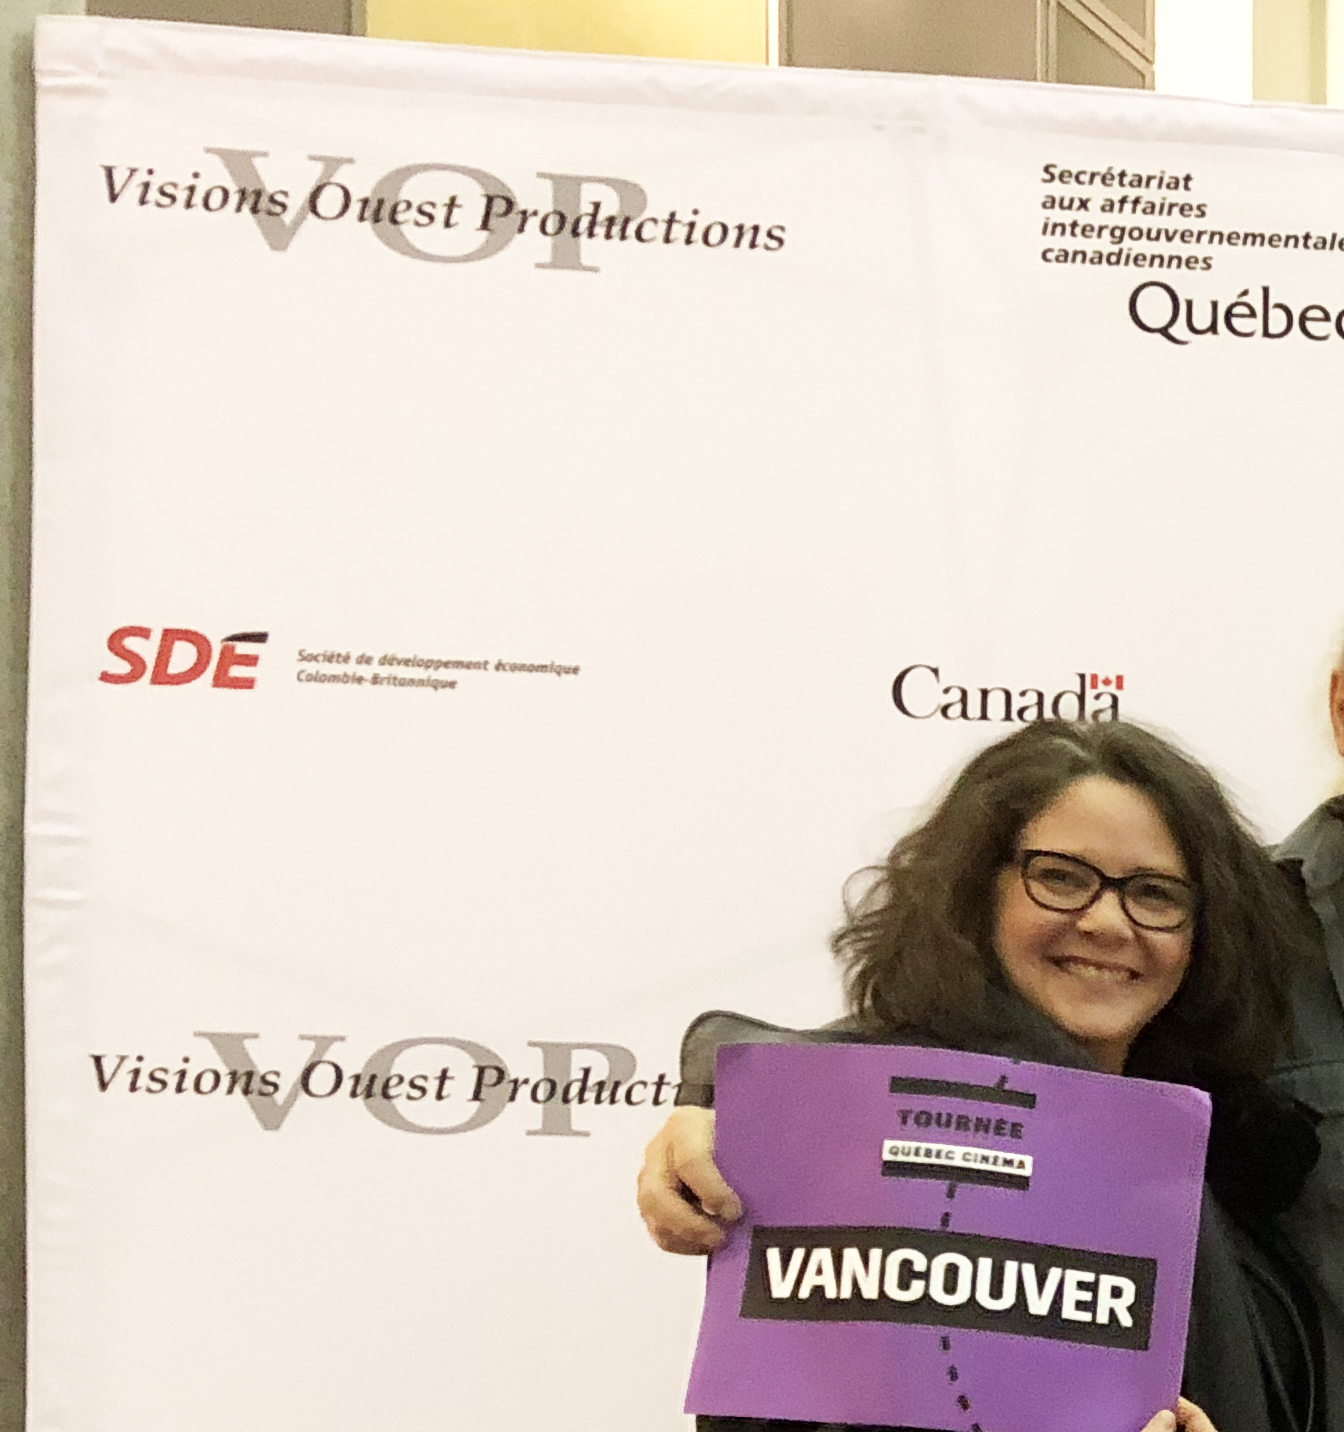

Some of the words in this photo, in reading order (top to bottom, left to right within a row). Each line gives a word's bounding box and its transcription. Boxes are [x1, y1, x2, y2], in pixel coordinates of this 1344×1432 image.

[1041, 162, 1194, 192] Secrétariat
[100, 164, 289, 219] Visions
[309, 181, 462, 229] Ouest
[478, 194, 786, 251] Productions
[204, 147, 649, 272] VOP
[1041, 192, 1092, 213] aux
[1099, 193, 1208, 219] affaires
[1041, 245, 1214, 272] canadiennes
[297, 649, 350, 664] Société
[355, 653, 373, 665] de
[378, 653, 489, 671] développement
[494, 659, 580, 677] économique
[891, 664, 1120, 724] Canada
[88, 1054, 280, 1097] Visions
[300, 1060, 454, 1101] Ouest
[470, 1063, 686, 1108] Producti
[193, 1030, 638, 1137] VOP
[897, 1109, 1024, 1139] TOURNÉE
[889, 1145, 955, 1160] QUÉBEC
[962, 1151, 1026, 1169] CINÉMA
[766, 1246, 1136, 1328] VANCOUVER
